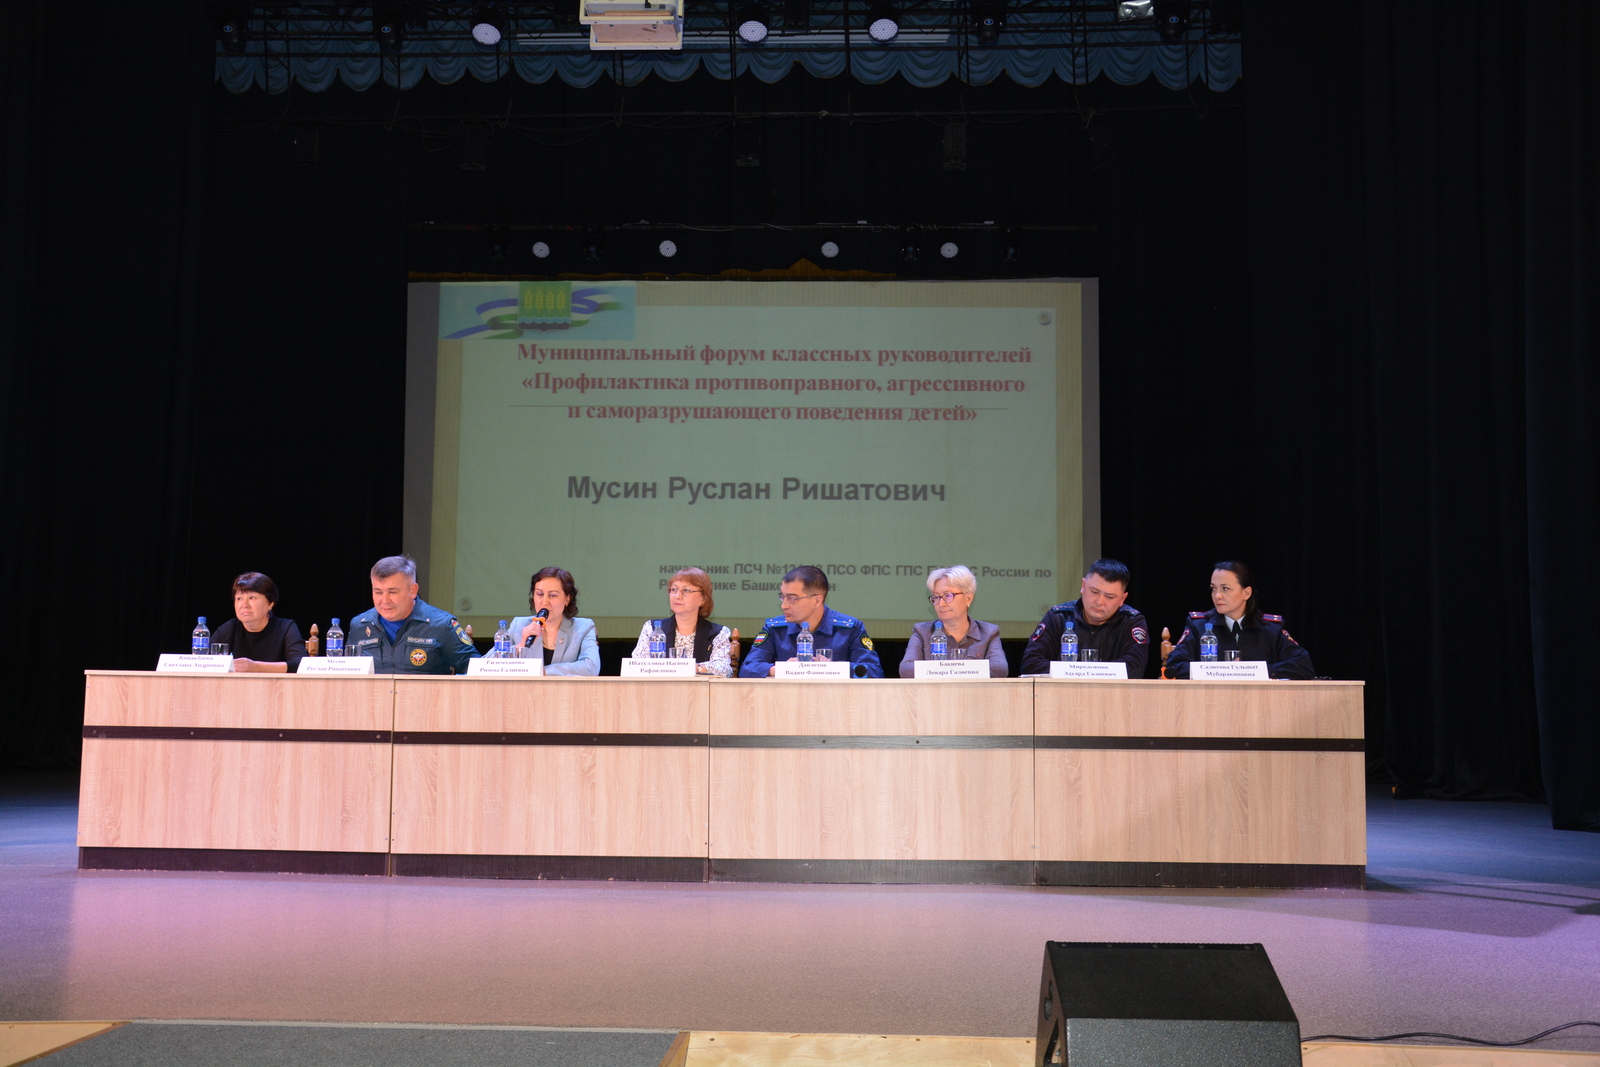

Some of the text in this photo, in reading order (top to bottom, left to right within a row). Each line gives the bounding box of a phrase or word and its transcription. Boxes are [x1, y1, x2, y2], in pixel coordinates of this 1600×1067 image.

[517, 343, 1032, 366] Муниципальный форум классных руководителей
[522, 372, 1025, 395] «Профилактика противоправного, агрессивного
[567, 405, 977, 423] и саморазрушающего поведения детей»
[567, 476, 946, 505] Мусин Руслан Ришатович
[659, 564, 730, 574] начьник
[733, 563, 763, 574] ПСЧ
[827, 564, 856, 575] ПСО
[860, 564, 891, 576] ФПС
[896, 565, 923, 576] ГПС
[982, 566, 1030, 578] России
[1035, 568, 1052, 579] по
